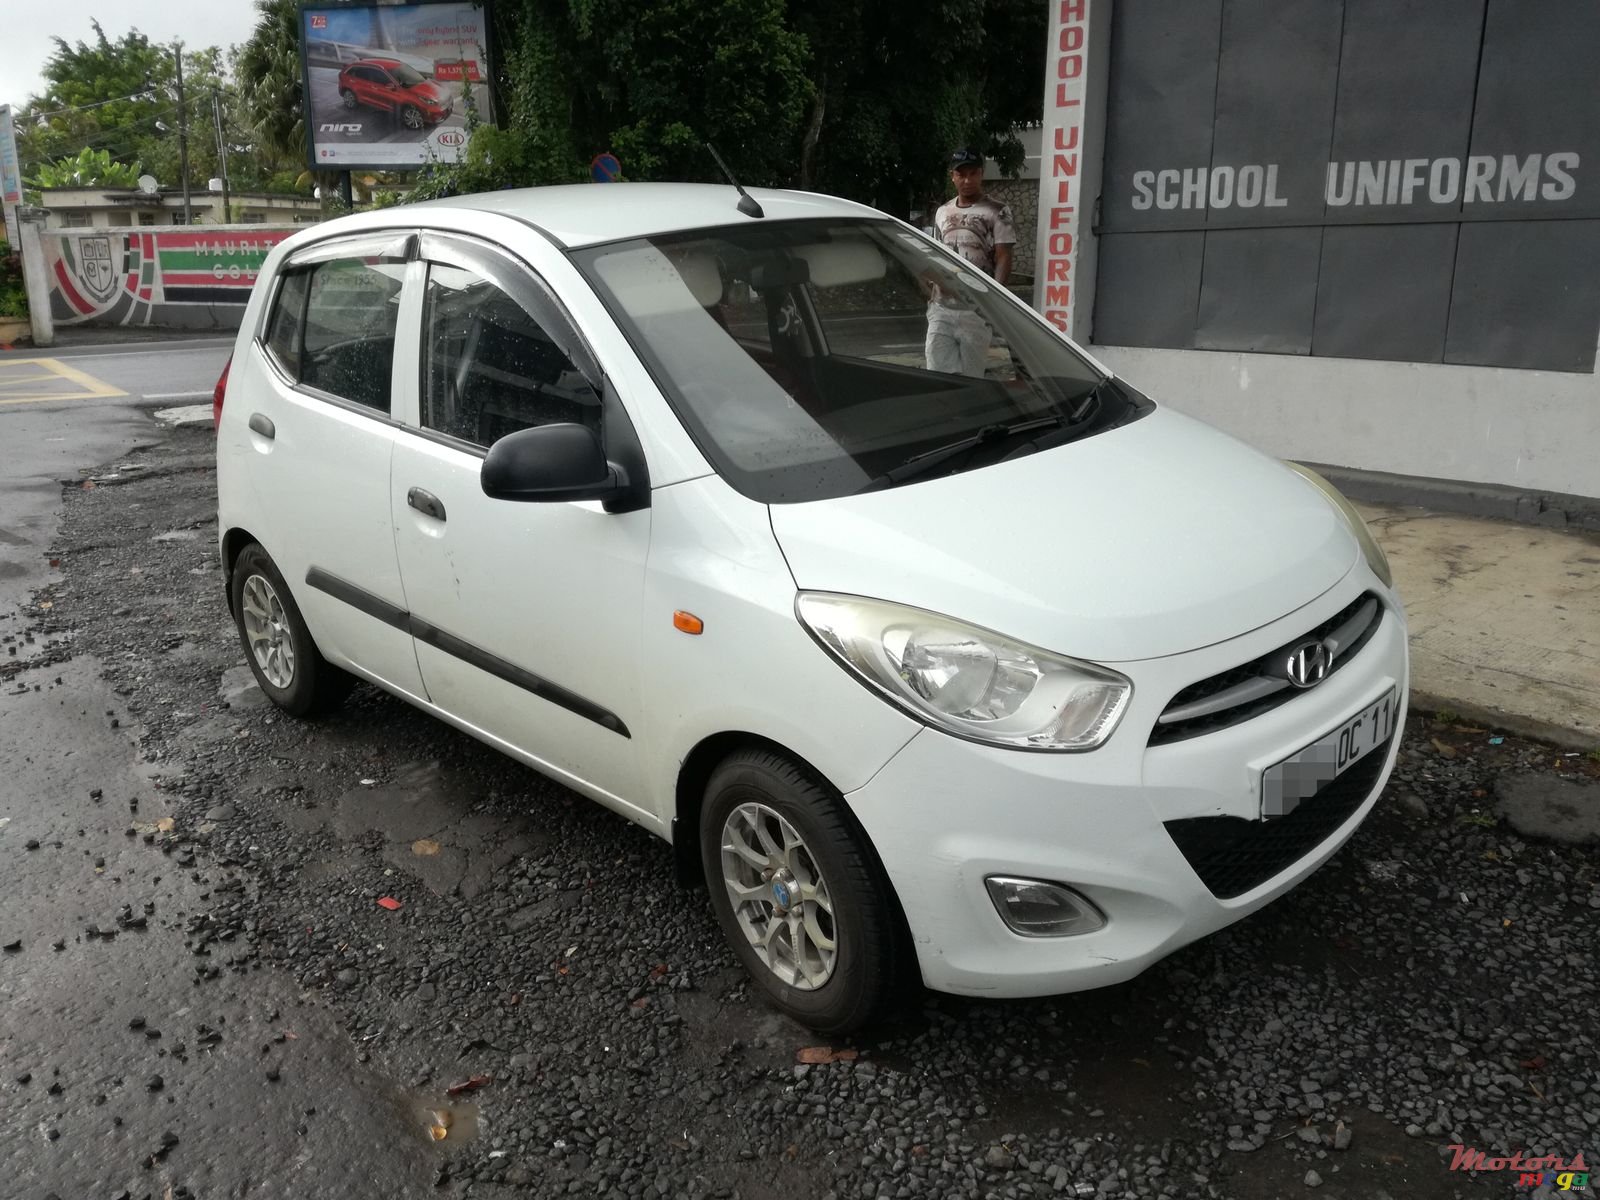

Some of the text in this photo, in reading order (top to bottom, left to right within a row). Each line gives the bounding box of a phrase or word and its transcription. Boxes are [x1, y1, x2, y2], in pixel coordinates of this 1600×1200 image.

[435, 25, 460, 35] hybrid
[461, 25, 477, 33] SUV
[442, 135, 460, 144] KIA
[1131, 152, 1580, 211] SCHOOL UNIFORMS
[1046, 126, 1079, 332] UNIFORMS
[194, 240, 283, 257] MAURIT
[1372, 699, 1390, 743] 11
